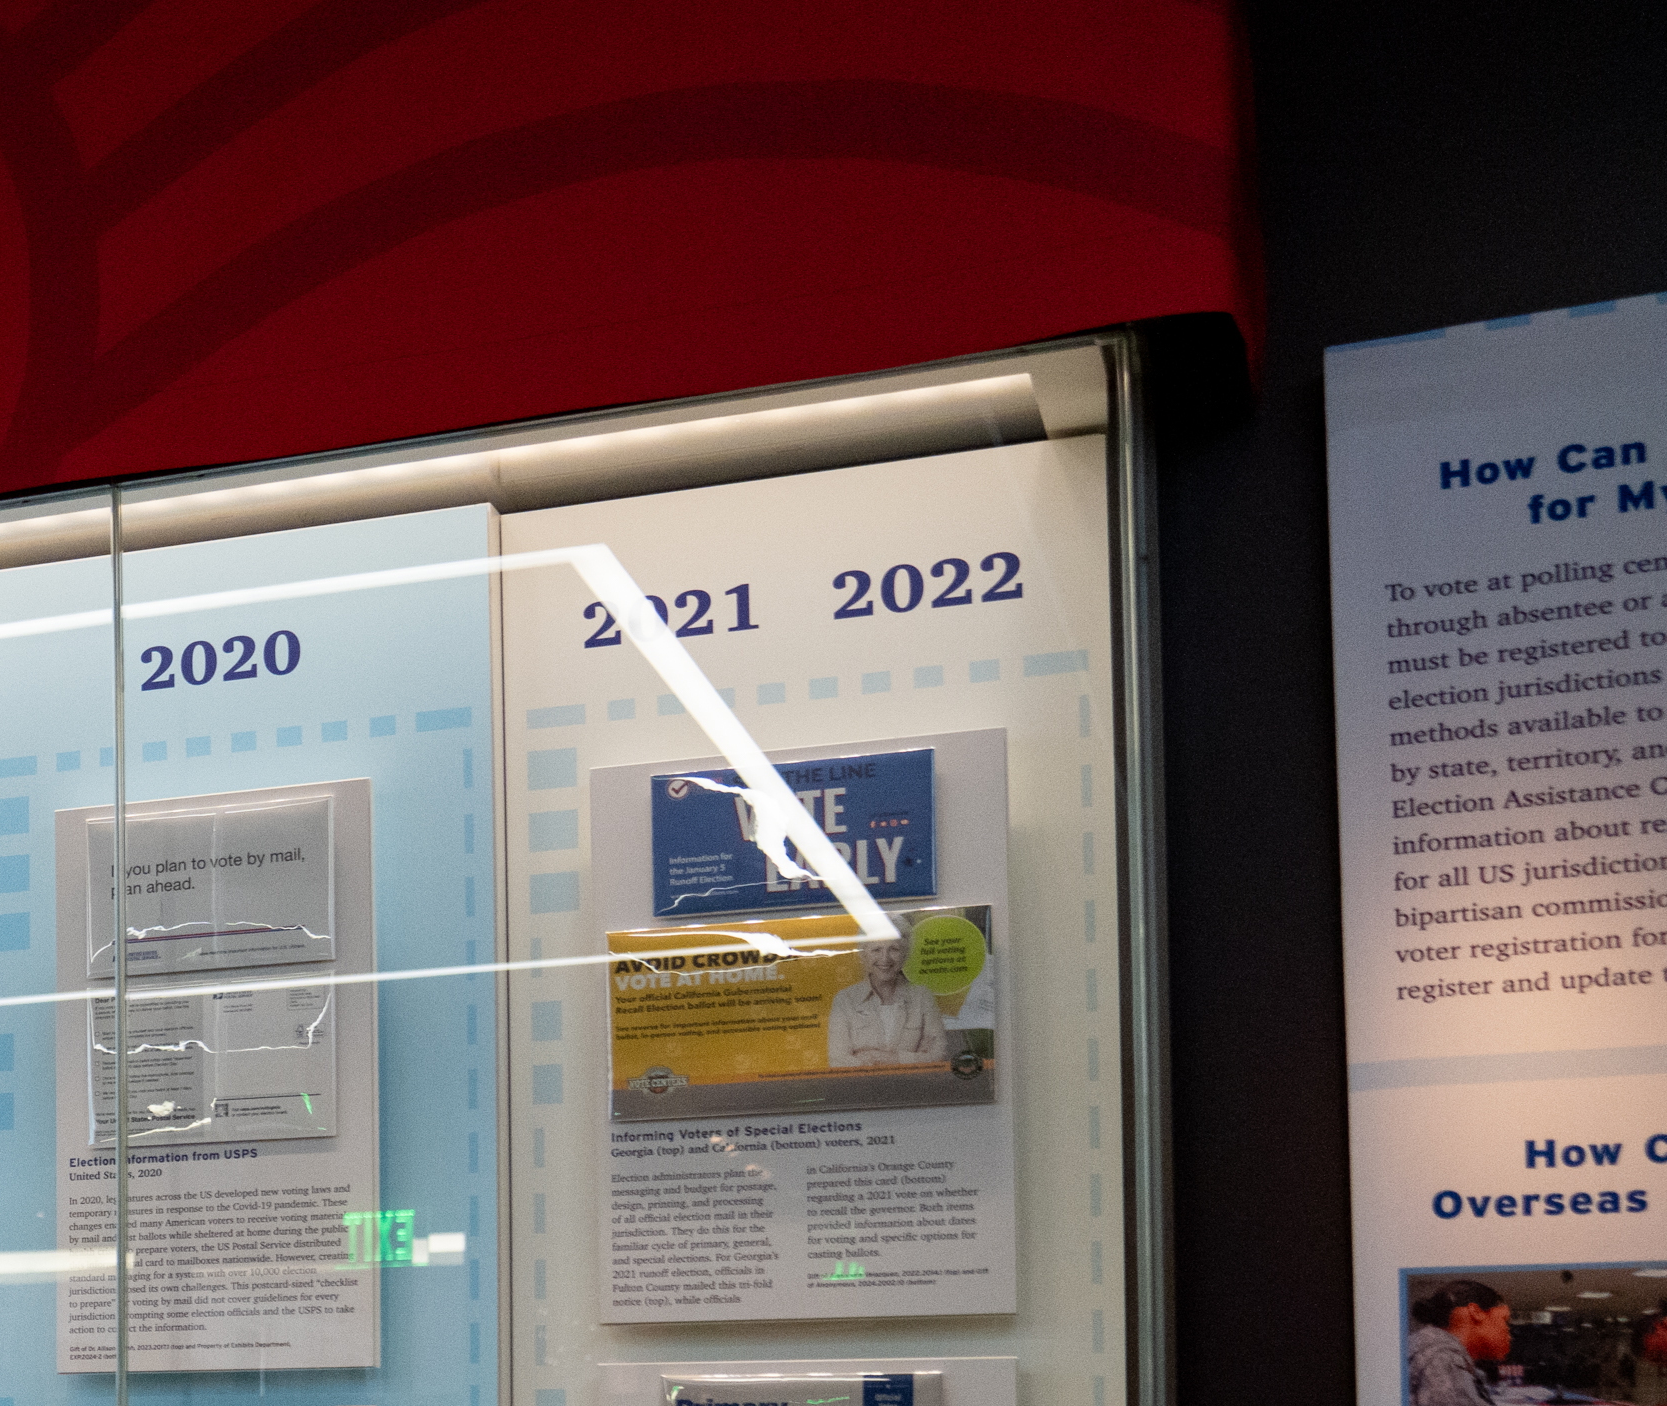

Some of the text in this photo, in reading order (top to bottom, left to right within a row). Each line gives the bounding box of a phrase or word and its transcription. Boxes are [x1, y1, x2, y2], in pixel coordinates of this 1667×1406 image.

[1441, 442, 1646, 489] How Can
[1528, 494, 1595, 524] for
[833, 552, 1023, 619] 2022
[1385, 563, 1614, 601] To vote at polling
[584, 583, 760, 648] 2021
[141, 630, 300, 691] 2020
[1389, 669, 1662, 710] election jurisdictions
[126, 847, 306, 879] you plan to vote by mail,
[111, 877, 195, 901] pan ahead.
[614, 972, 673, 992] VOTE
[677, 970, 704, 988] AT
[611, 1121, 862, 1143] Informing Voters of Special Elections
[1526, 1140, 1621, 1168] How
[1433, 1190, 1647, 1219] Overseas
